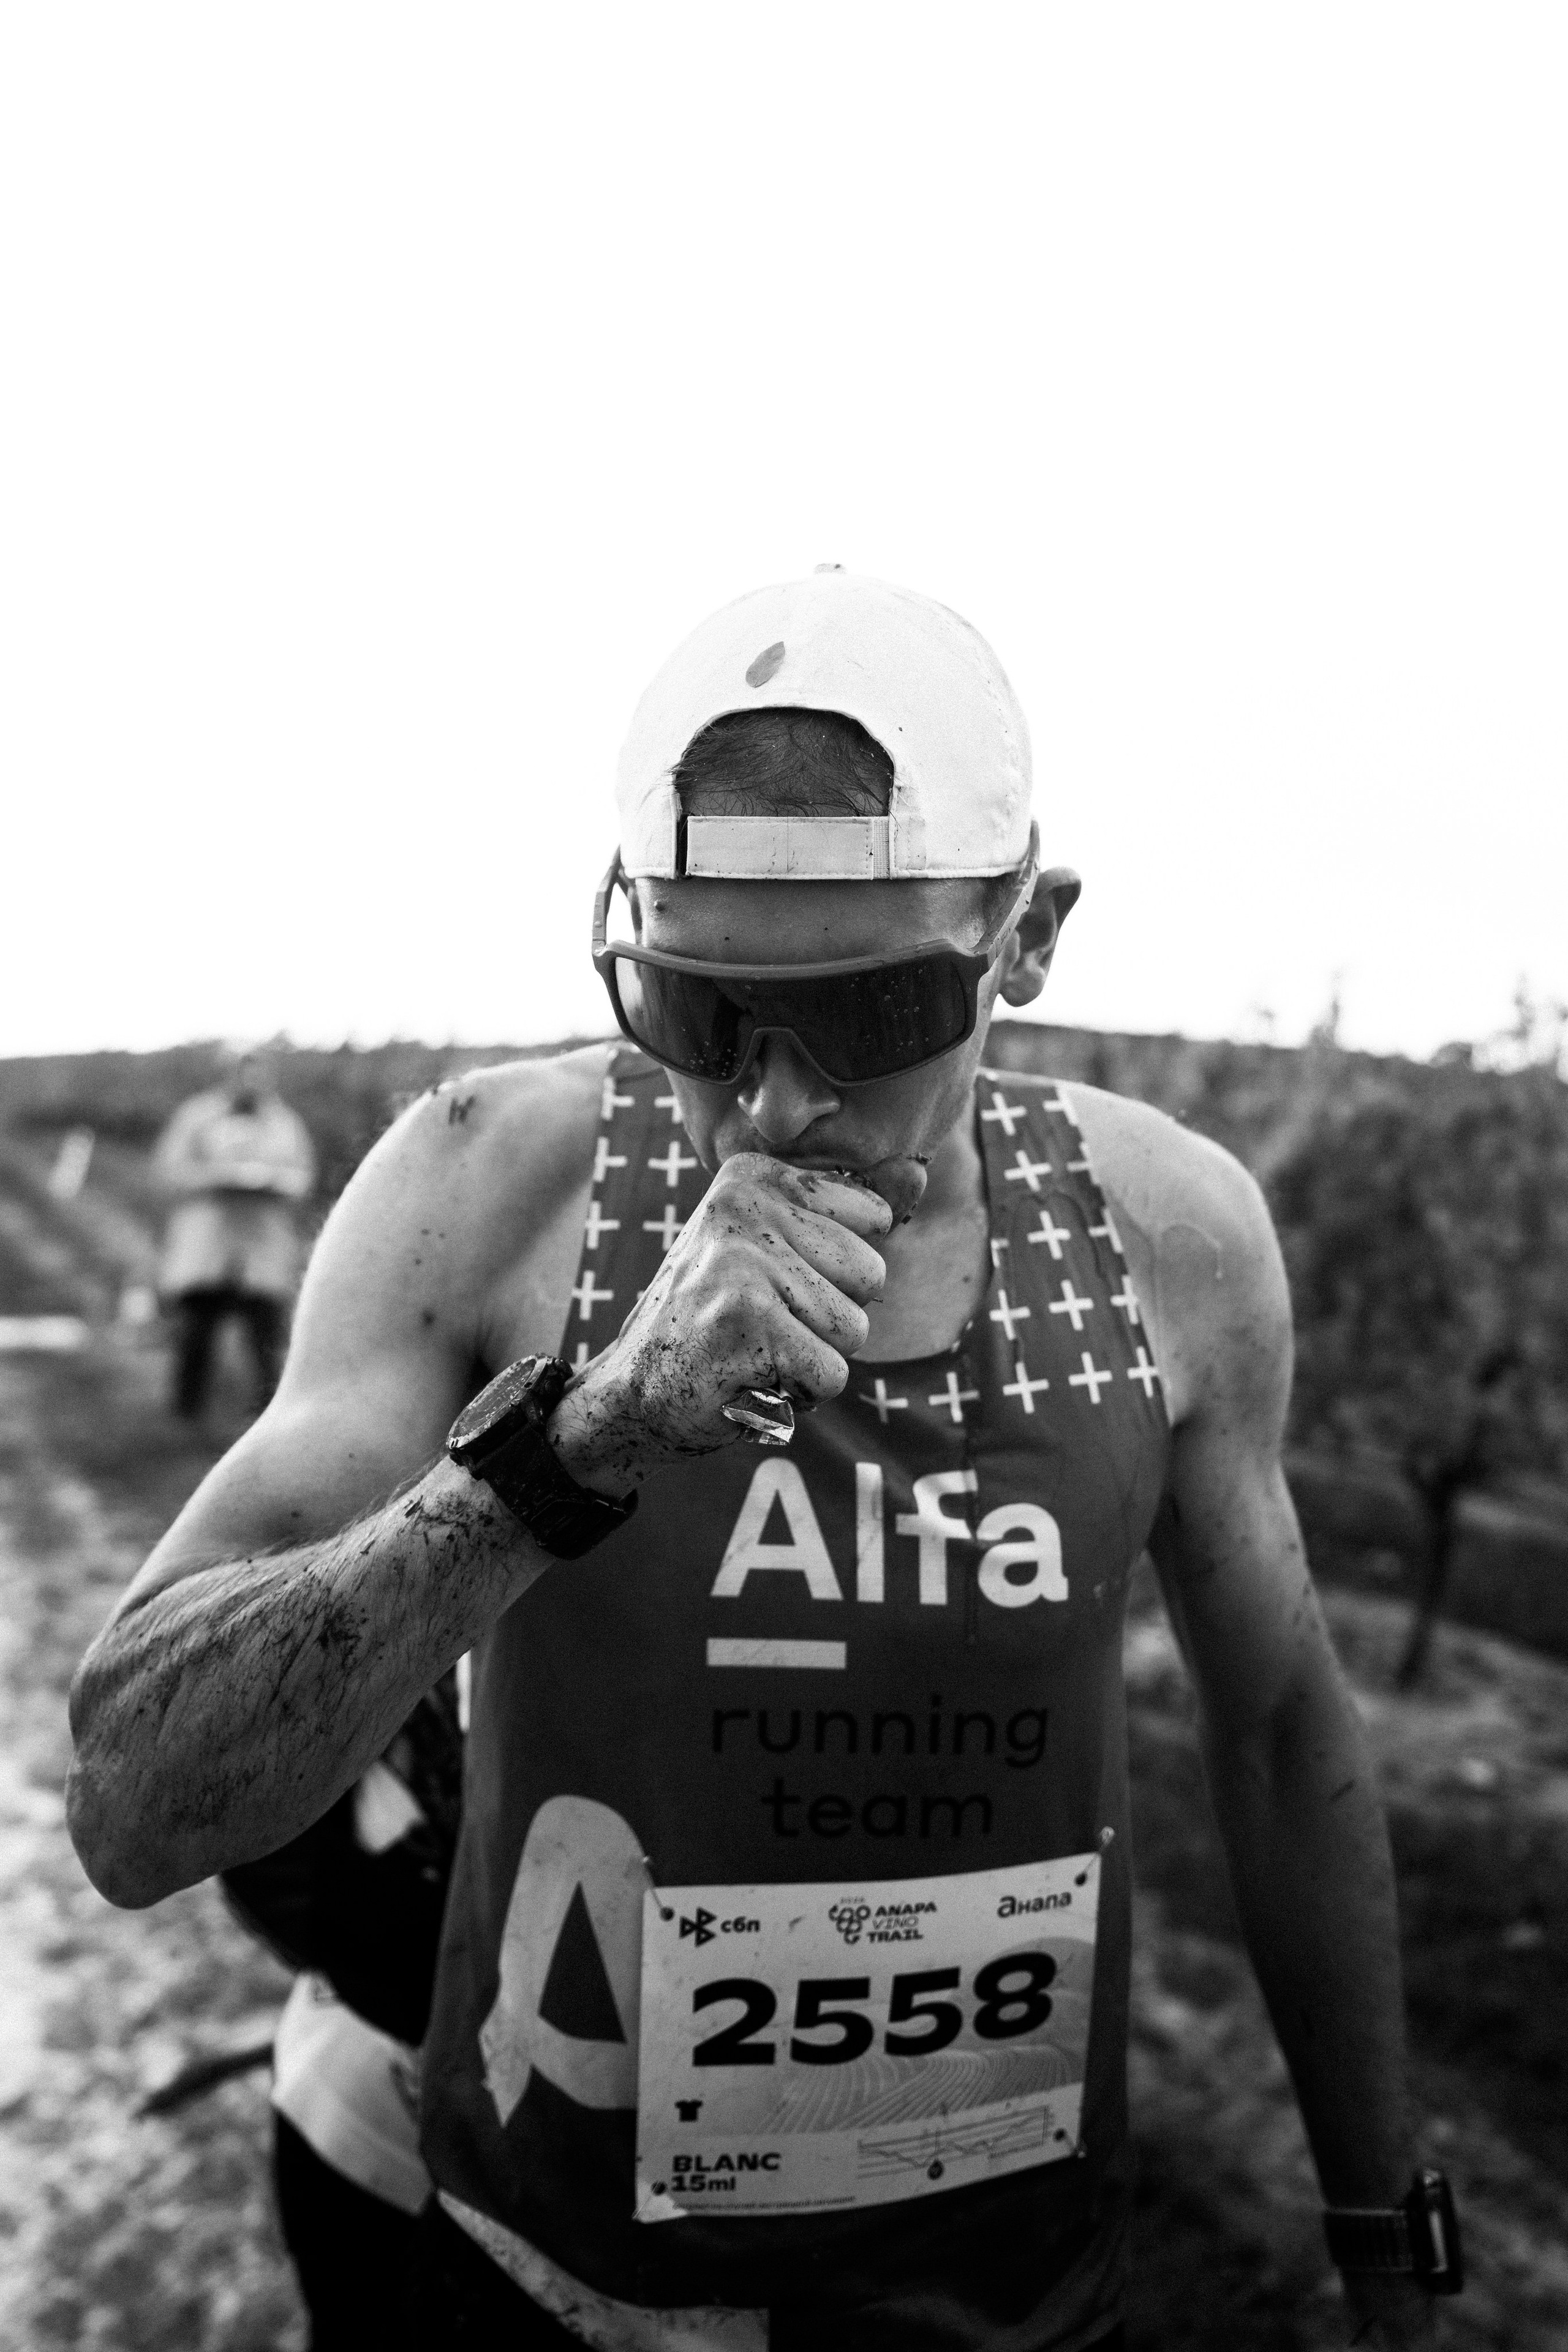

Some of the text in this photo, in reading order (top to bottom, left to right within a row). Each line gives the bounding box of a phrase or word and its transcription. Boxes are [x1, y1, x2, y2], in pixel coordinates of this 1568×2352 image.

[710, 1457, 1069, 1608] Alfa
[712, 1694, 1048, 1770] running
[761, 1777, 992, 1838] team
[875, 1901, 938, 1917] ANAPA
[720, 1916, 761, 1934] сбп
[872, 1916, 919, 1930] VINO
[867, 1929, 924, 1943] TRAIL
[693, 1952, 1057, 2066] 2558
[672, 2151, 782, 2173] BLANC
[671, 2174, 737, 2193] 15ml
